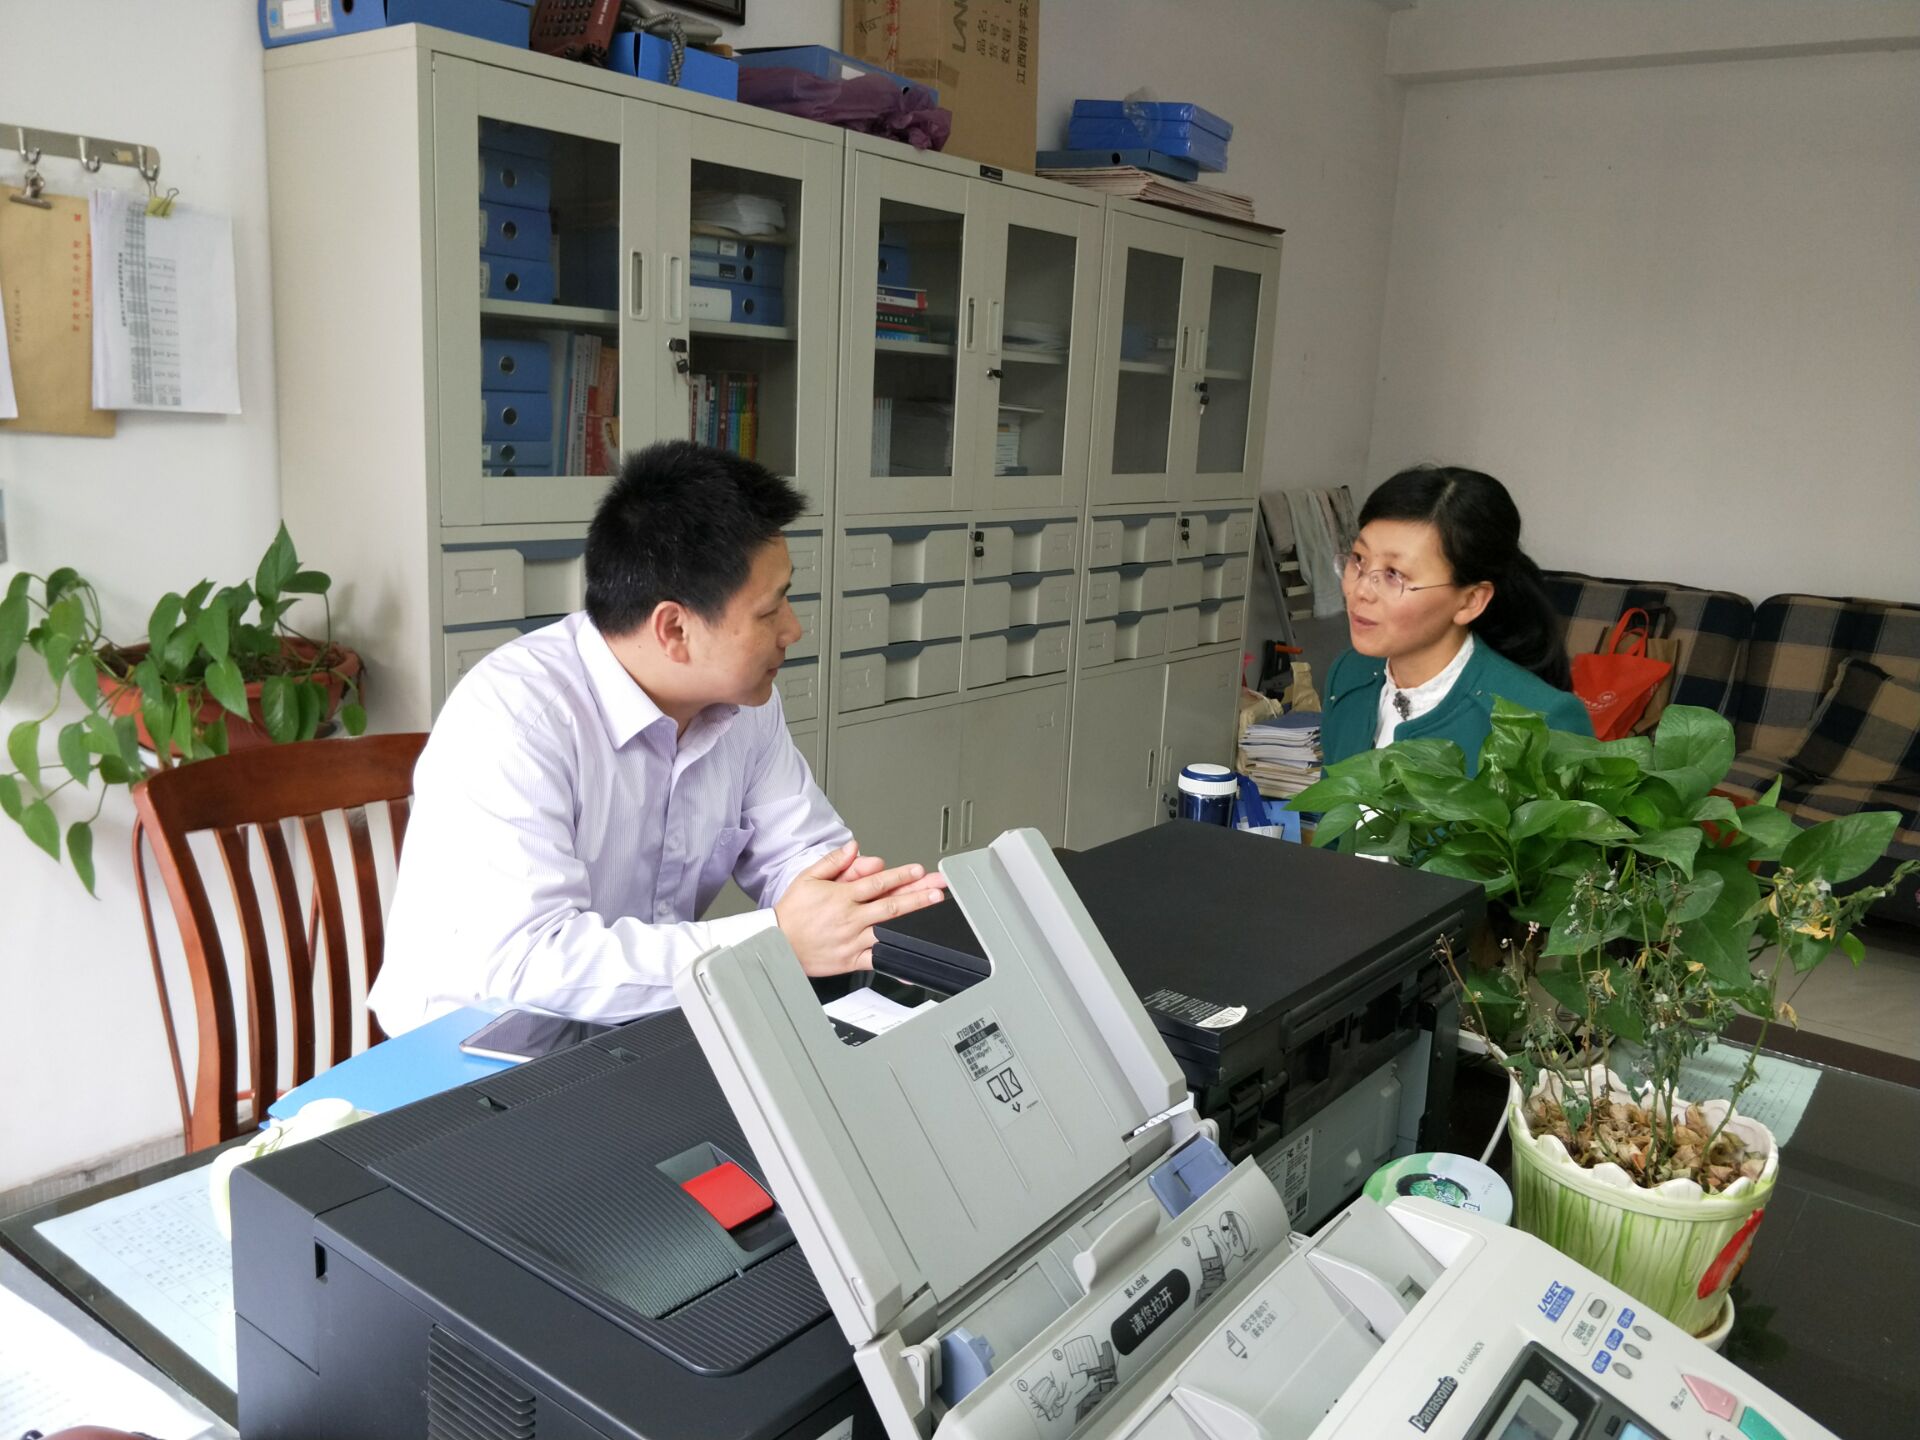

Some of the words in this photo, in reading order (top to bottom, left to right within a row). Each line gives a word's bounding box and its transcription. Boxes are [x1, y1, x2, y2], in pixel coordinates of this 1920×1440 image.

[1129, 1286, 1174, 1335] 请您拉开
[1537, 1280, 1563, 1313] LASER
[1409, 1376, 1458, 1432] Panasonic
